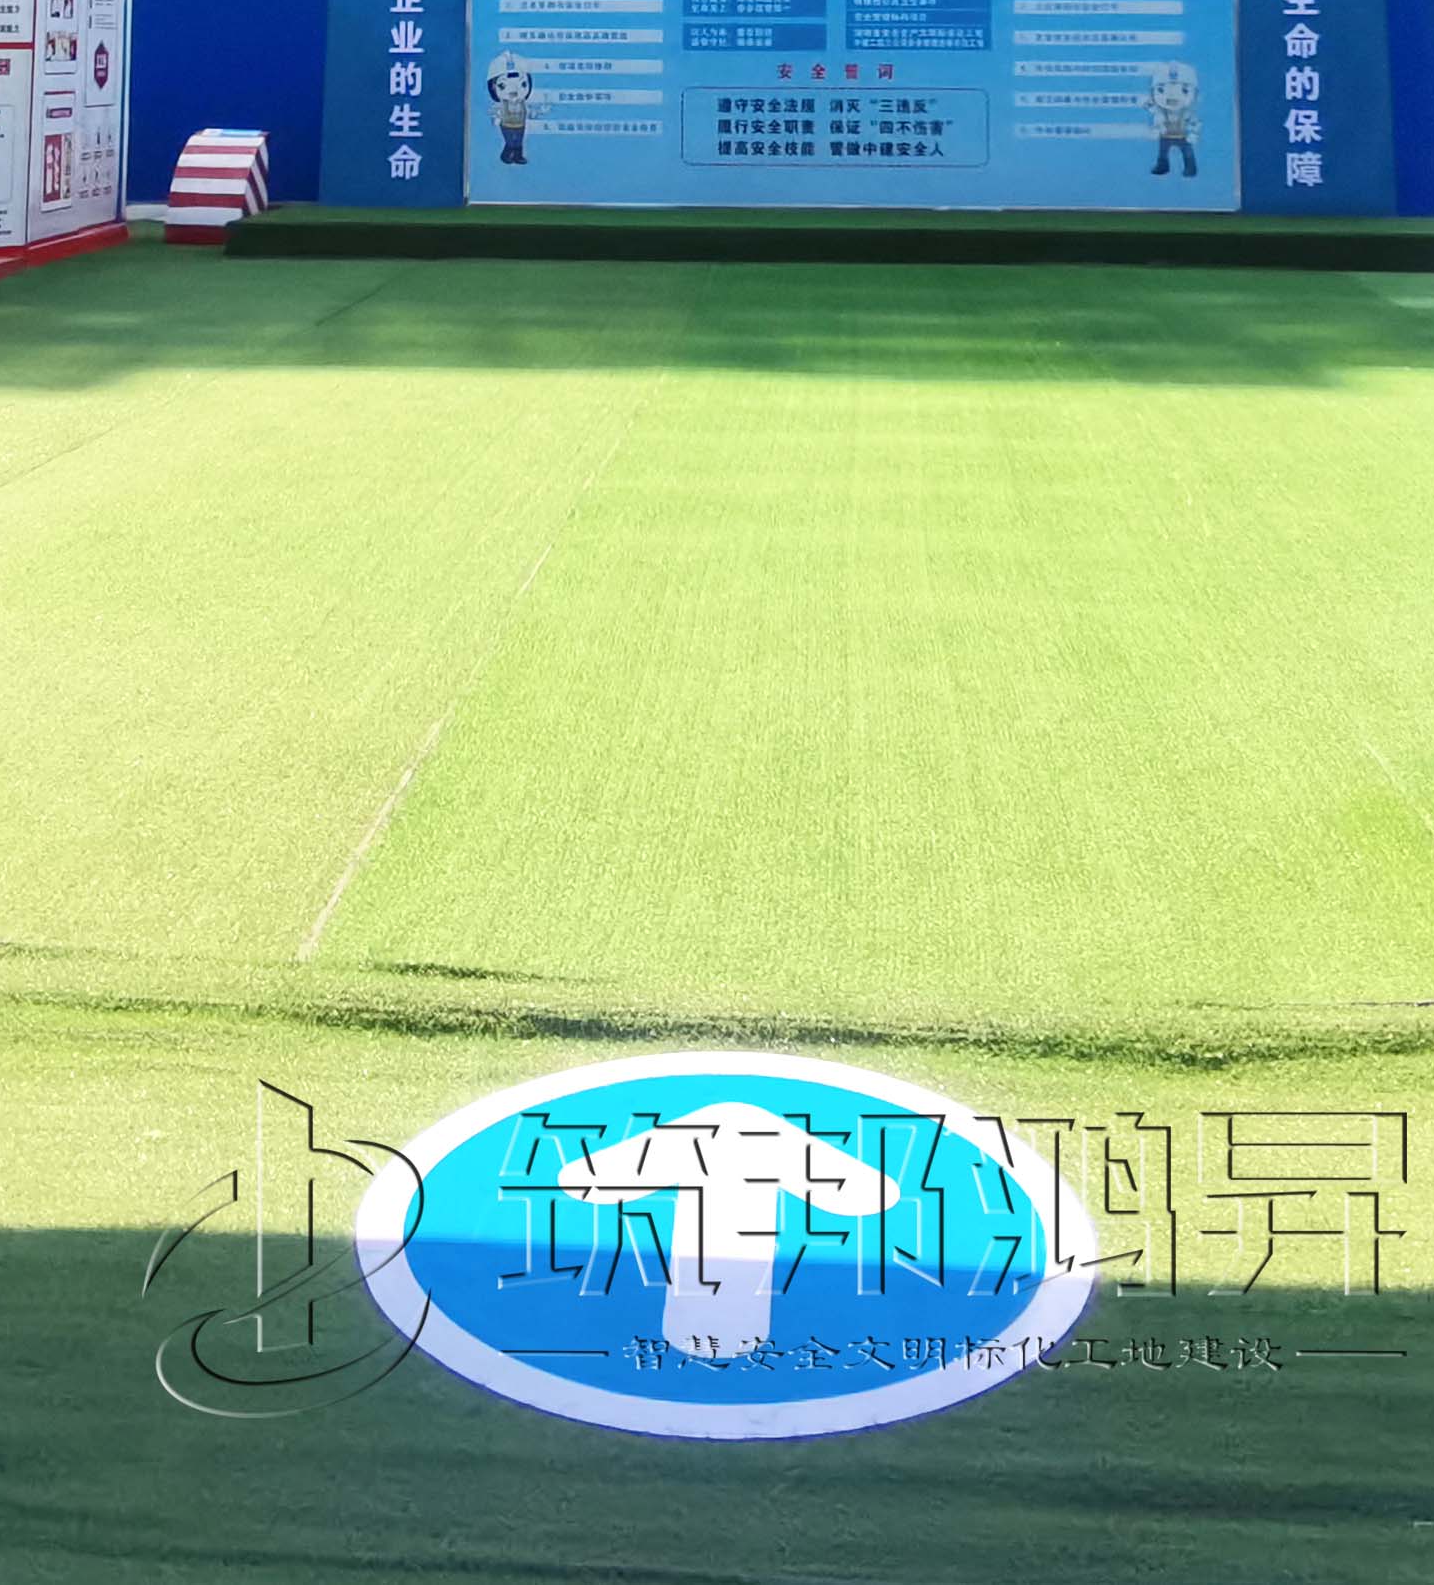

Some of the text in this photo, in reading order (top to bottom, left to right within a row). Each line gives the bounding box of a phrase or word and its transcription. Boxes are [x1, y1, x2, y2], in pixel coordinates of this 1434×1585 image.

[717, 98, 816, 114] 遵守安全法规
[717, 119, 816, 136] 履行安全职责
[717, 141, 816, 157] 提高安全技能
